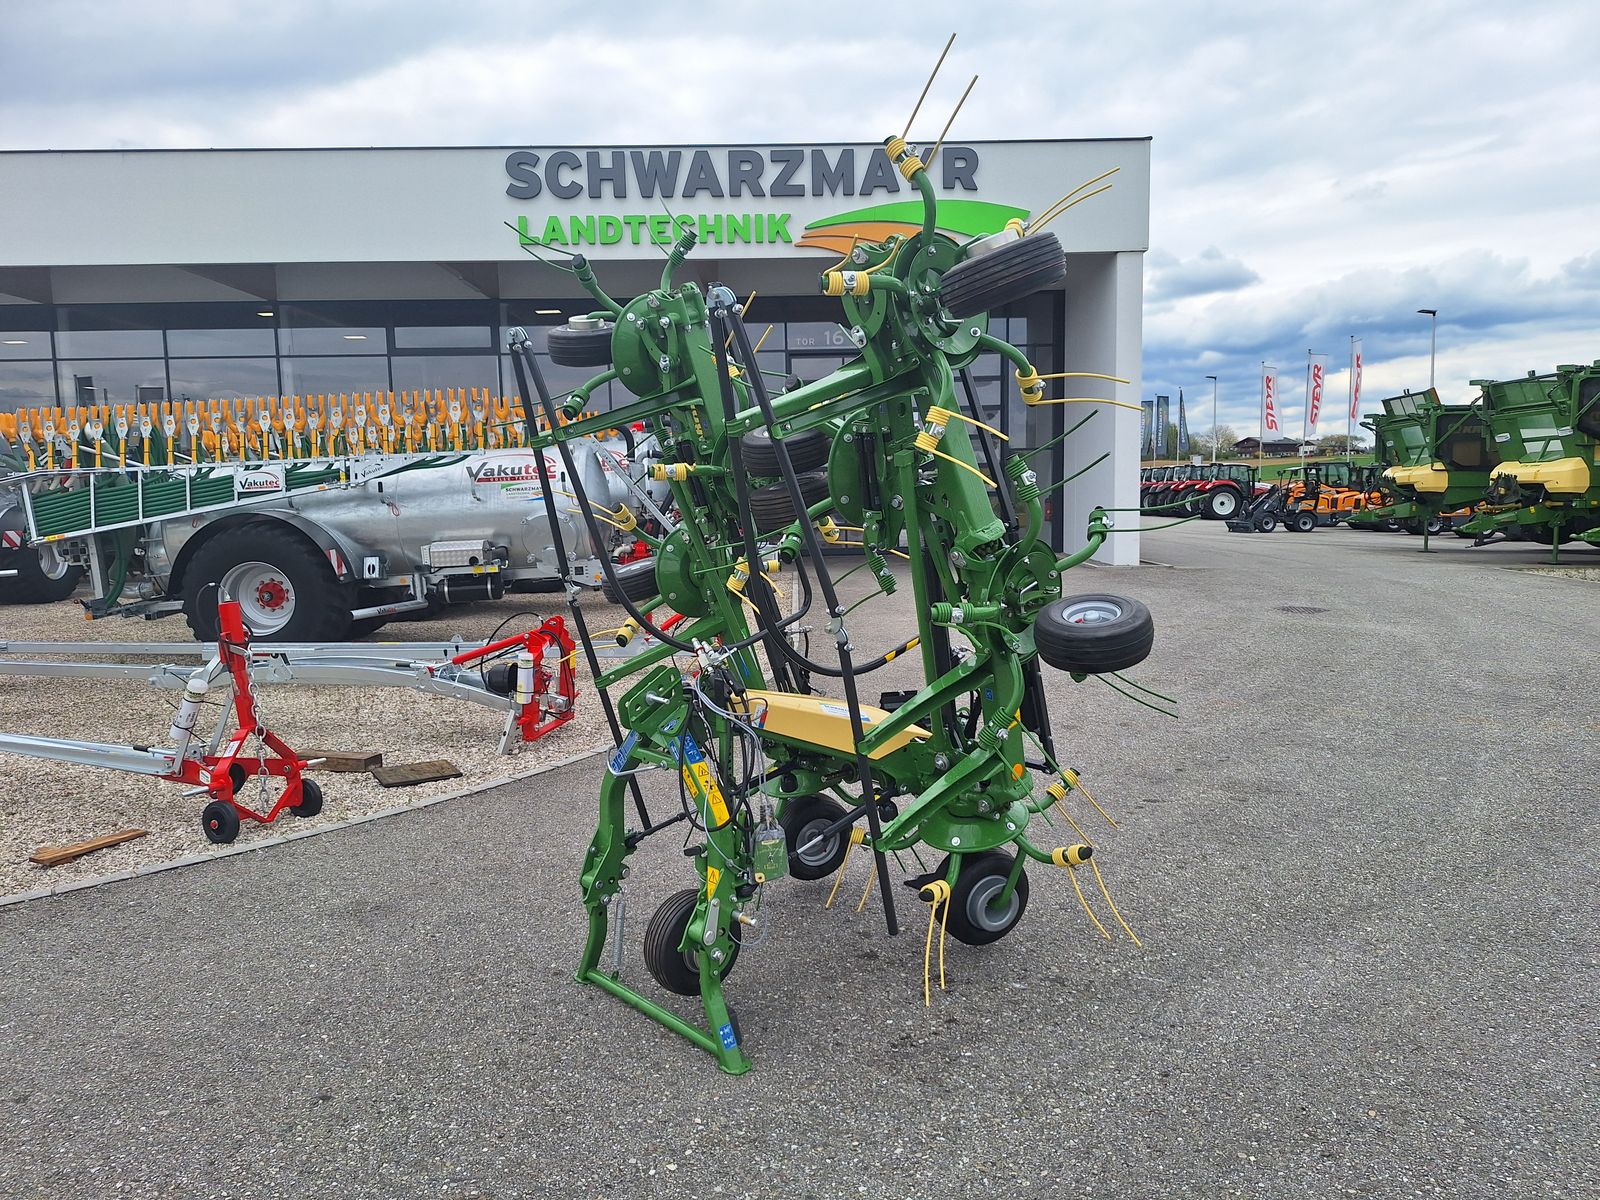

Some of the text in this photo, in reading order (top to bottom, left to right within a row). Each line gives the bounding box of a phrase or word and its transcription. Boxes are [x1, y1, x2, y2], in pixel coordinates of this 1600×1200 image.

[517, 213, 793, 246] LANDTECHNIK
[795, 330, 844, 346] TOR 16
[1265, 375, 1279, 432] STEYR
[1309, 364, 1322, 425] STEYR
[239, 477, 280, 490] Vakutec
